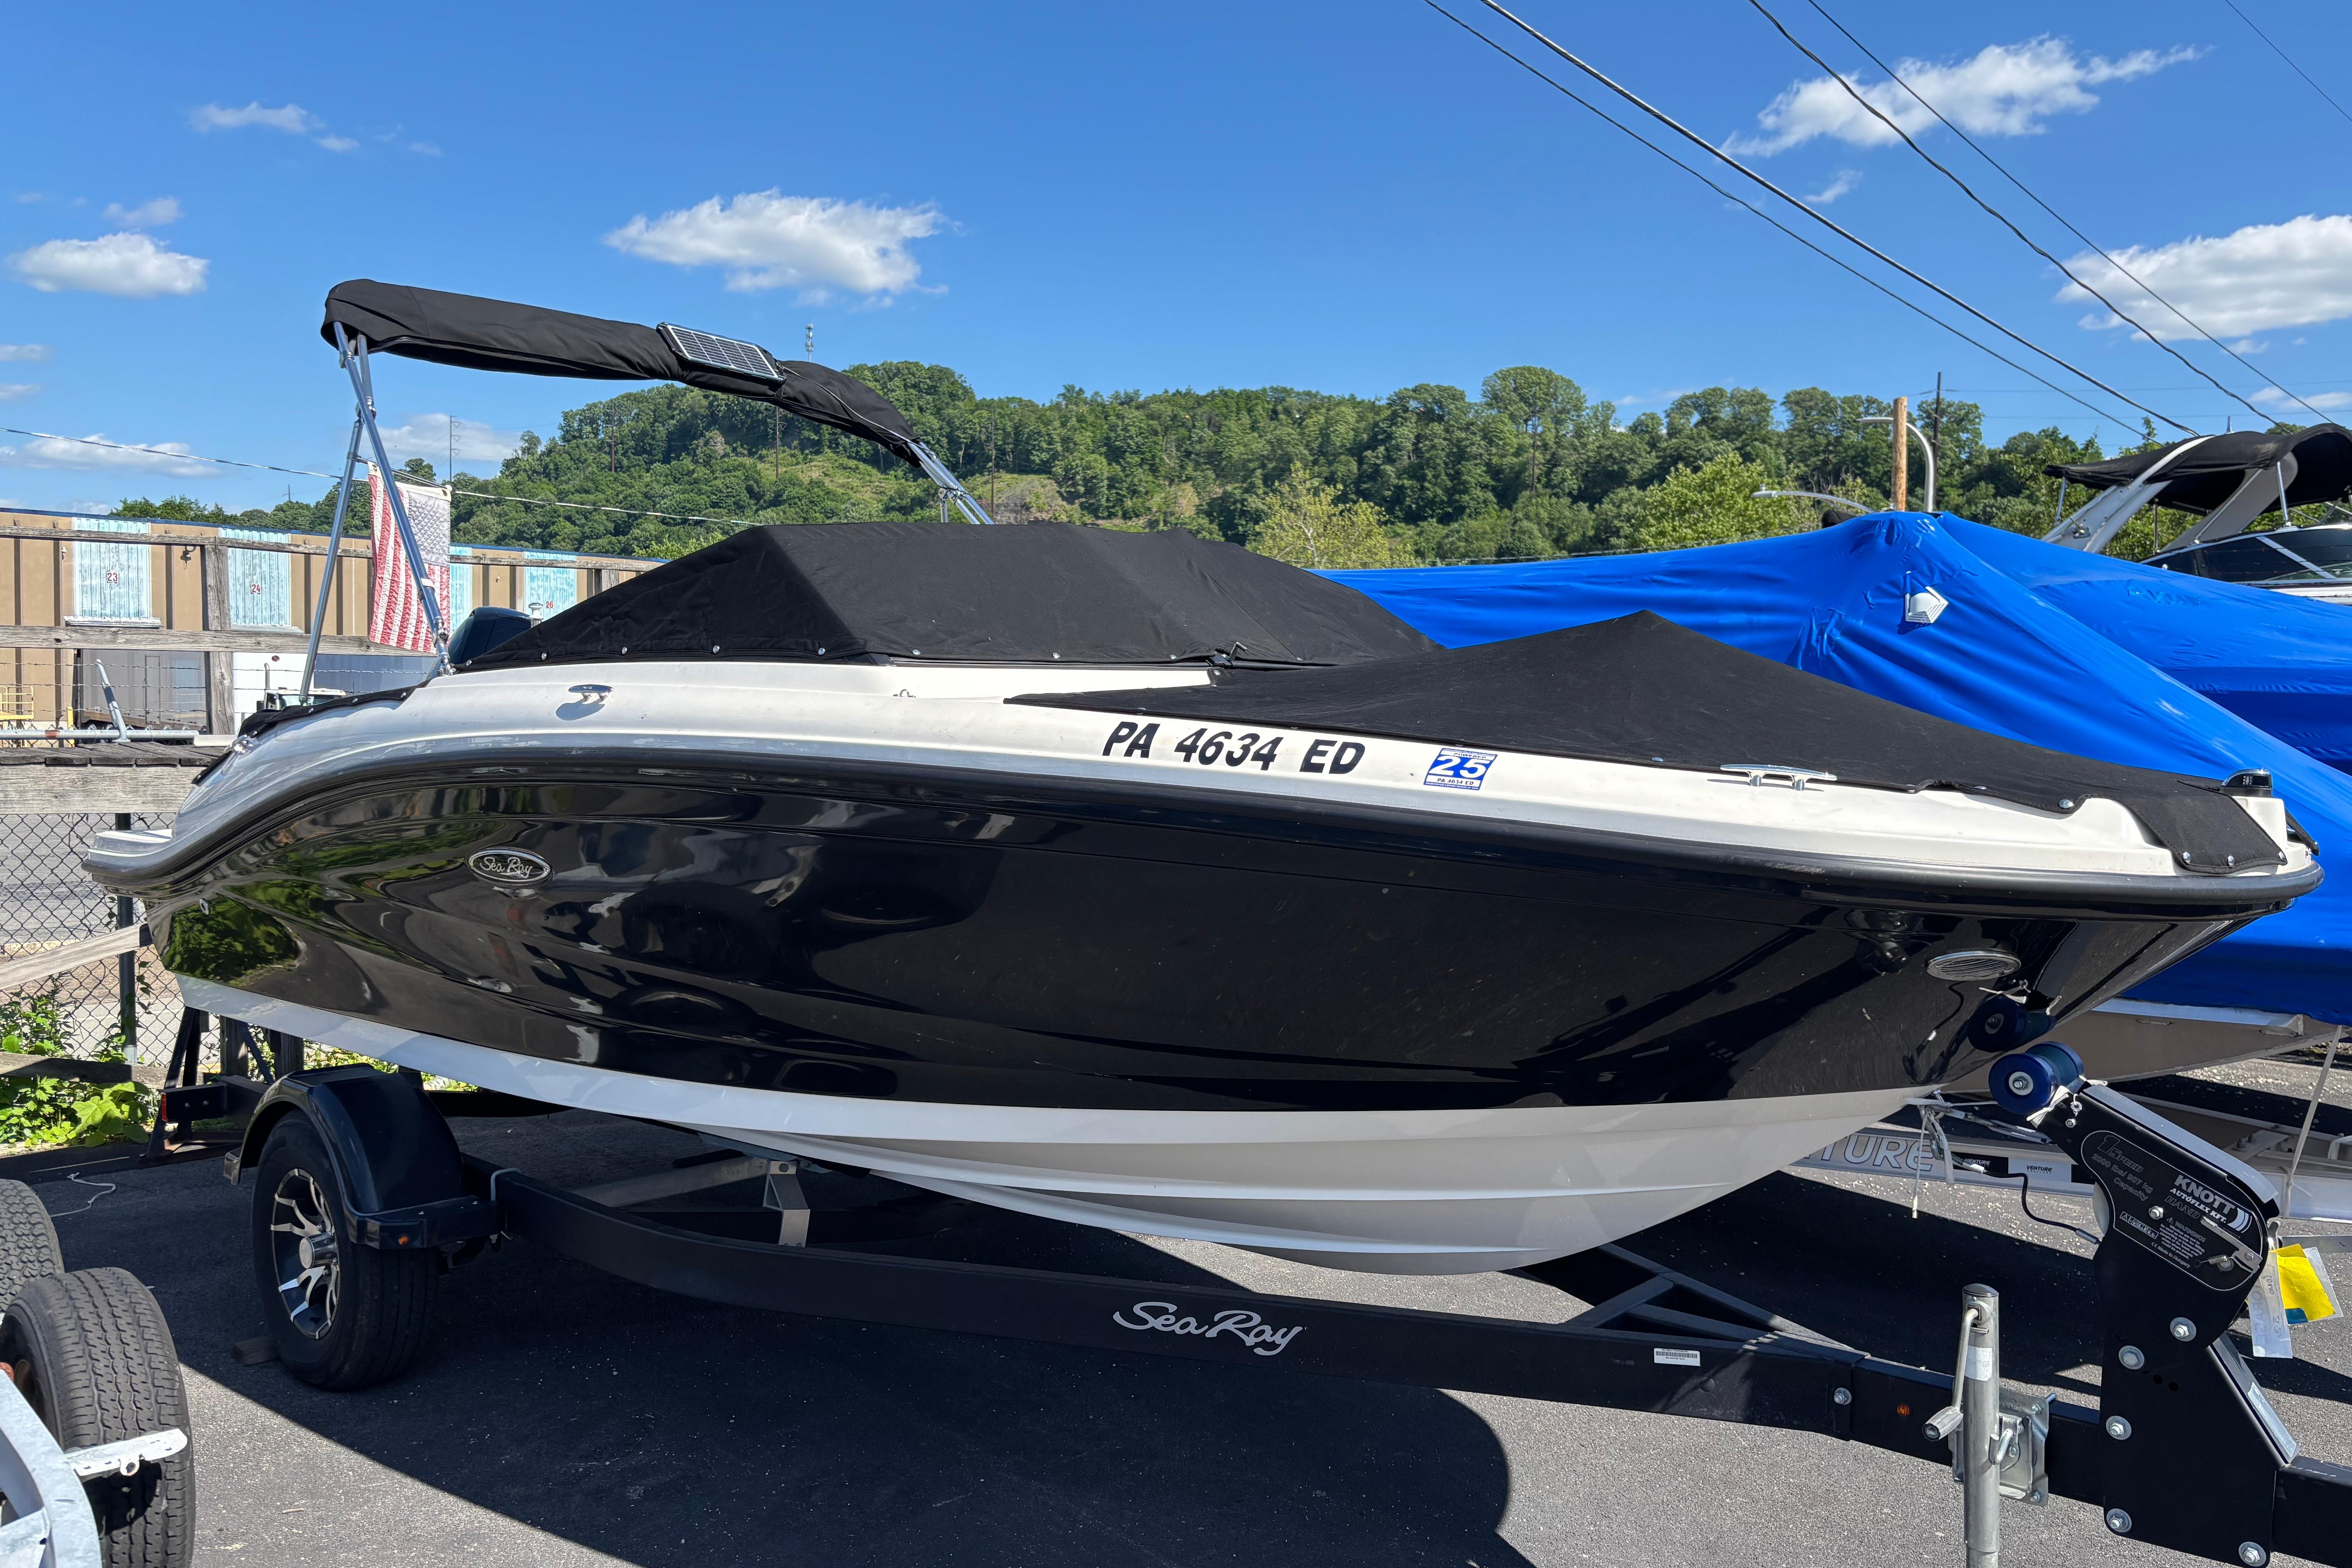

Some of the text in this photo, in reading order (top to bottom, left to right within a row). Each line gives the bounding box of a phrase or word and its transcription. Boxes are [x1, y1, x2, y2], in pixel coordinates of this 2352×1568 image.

[107, 572, 118, 581] 23
[252, 584, 260, 593] 24
[1101, 721, 1365, 775] PA 4634 ED
[1429, 755, 1491, 778] 25
[480, 856, 533, 878] Sea Ray
[2114, 1177, 2148, 1201] Capacity
[2174, 1174, 2235, 1214] KNOTT
[2164, 1195, 2200, 1219] HAND
[2170, 1188, 2227, 1223] AUTÓFLEX KFT.
[1113, 1302, 1303, 1356] Sea Ray
